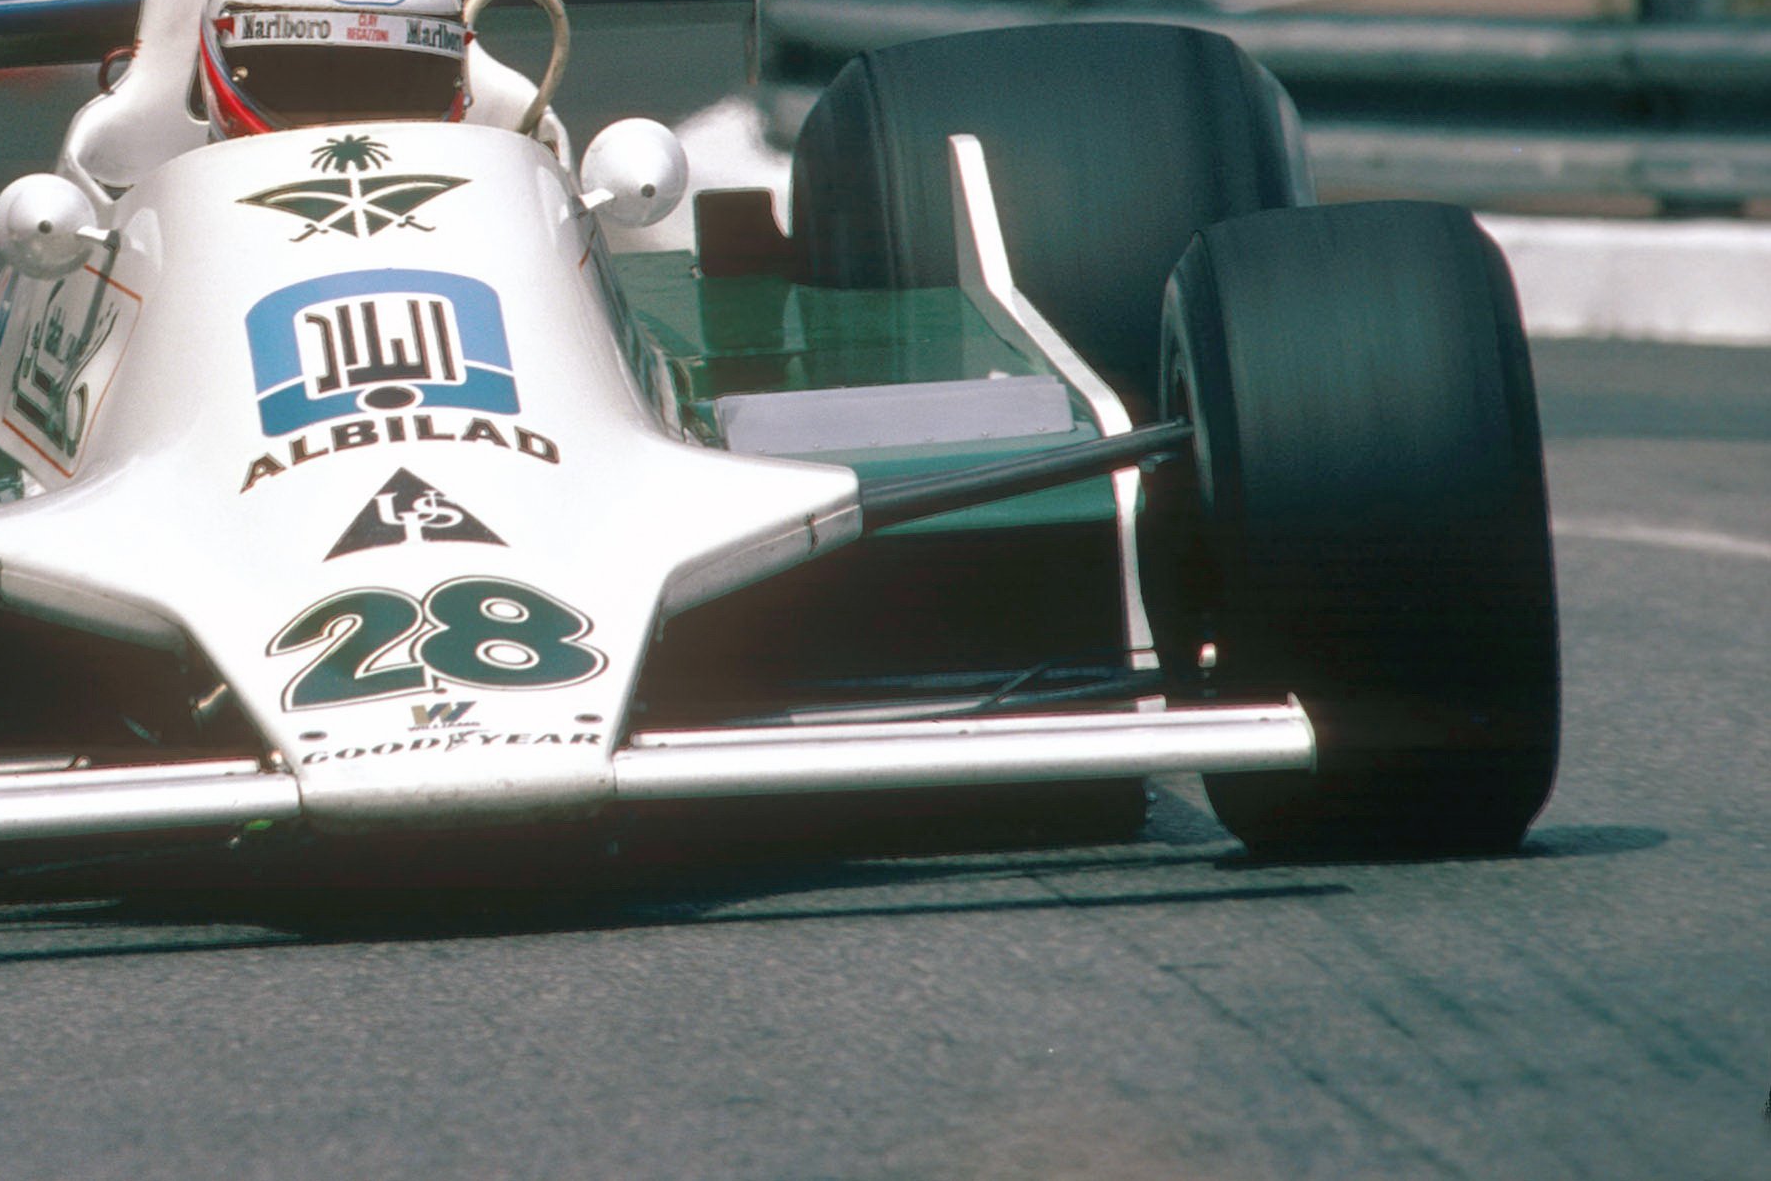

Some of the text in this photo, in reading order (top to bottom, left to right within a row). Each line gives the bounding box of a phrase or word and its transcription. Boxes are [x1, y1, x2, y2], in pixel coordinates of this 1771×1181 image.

[241, 13, 332, 41] Marlboro
[239, 415, 561, 495] ALBILAD
[265, 574, 610, 713] 28
